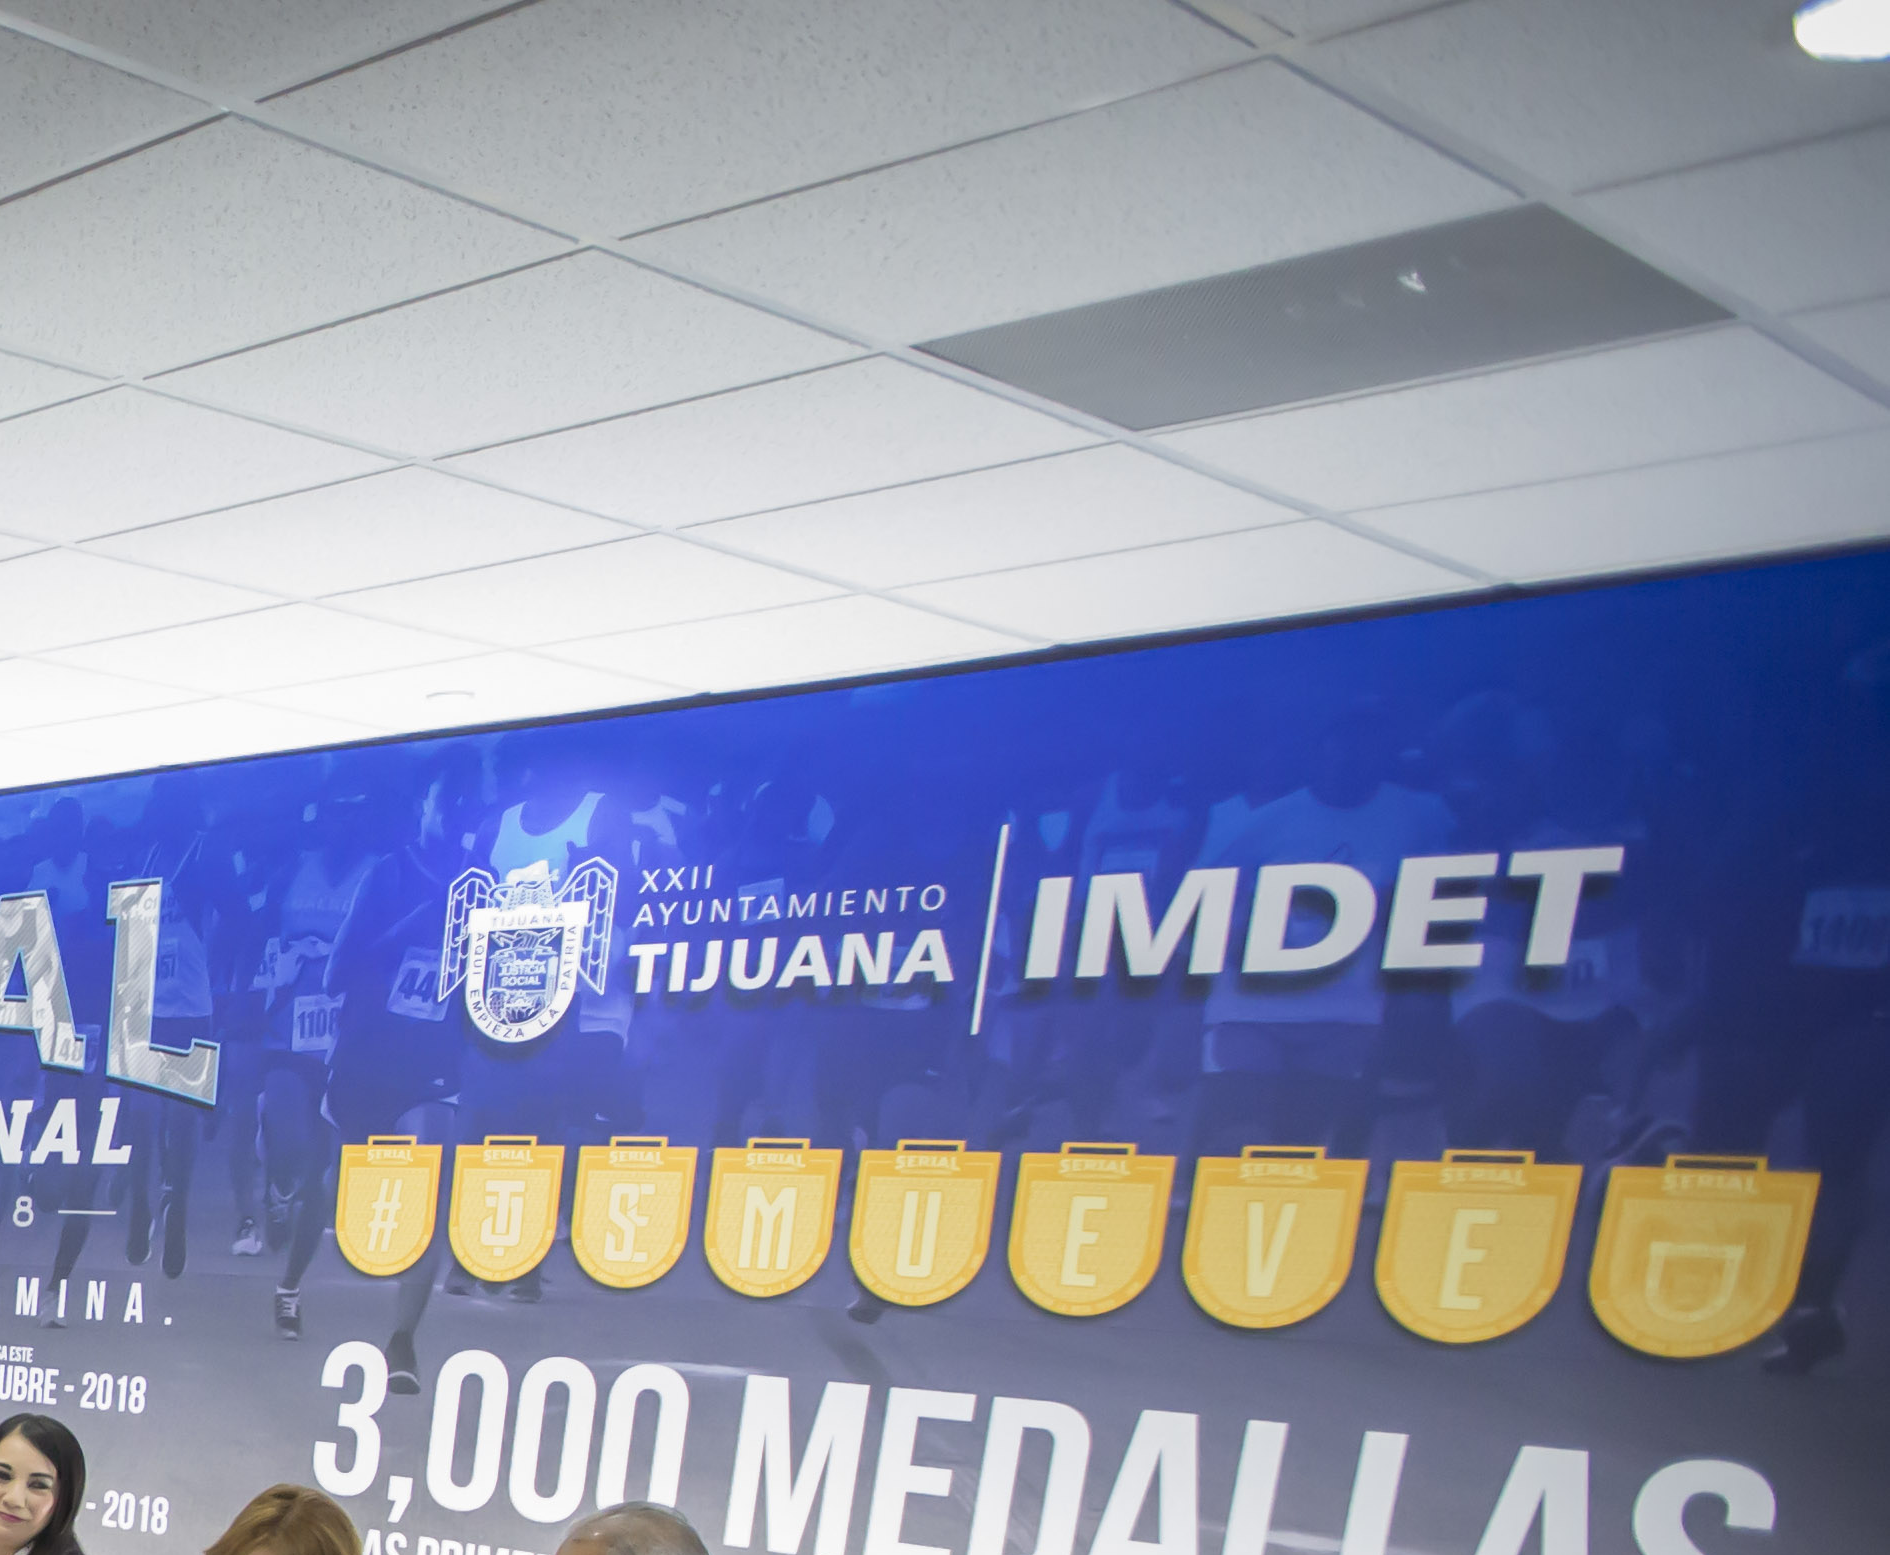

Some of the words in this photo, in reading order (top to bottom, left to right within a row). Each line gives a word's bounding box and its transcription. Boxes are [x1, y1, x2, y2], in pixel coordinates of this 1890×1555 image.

[638, 865, 714, 894] XXII
[491, 913, 565, 927] TIJUANA
[632, 884, 948, 928] AYUNTAMIENTO
[1025, 847, 1625, 980] IMDET
[561, 924, 579, 991] PATRIA
[628, 928, 956, 994] TIJUANA
[501, 976, 542, 987] SOCIAL
[470, 988, 525, 1039] EMPIEZA
[537, 1008, 560, 1028] LA
[9, 1345, 34, 1363] ESTE
[79, 1371, 148, 1414] 2018
[312, 1340, 691, 1524] 3,000
[101, 1489, 170, 1535] 2018
